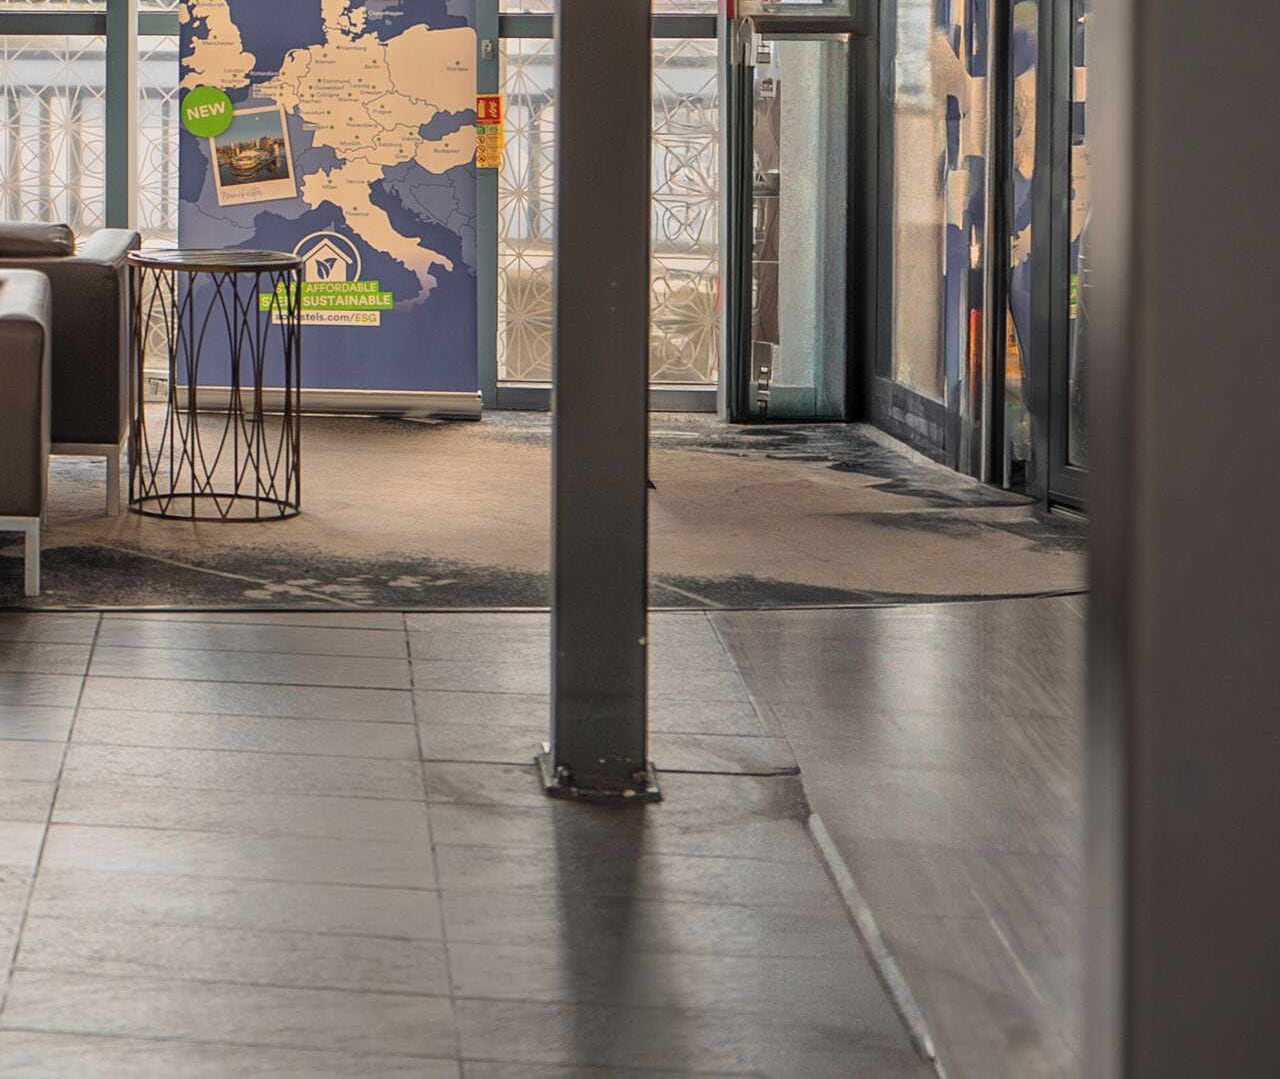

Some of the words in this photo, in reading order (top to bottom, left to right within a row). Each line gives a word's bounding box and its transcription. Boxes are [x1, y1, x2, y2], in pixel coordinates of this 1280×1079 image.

[368, 9, 404, 17] Copenhagen
[186, 101, 225, 121] NEW
[306, 282, 377, 293] AFFORDABLE
[303, 294, 391, 307] SUSTAINABLE
